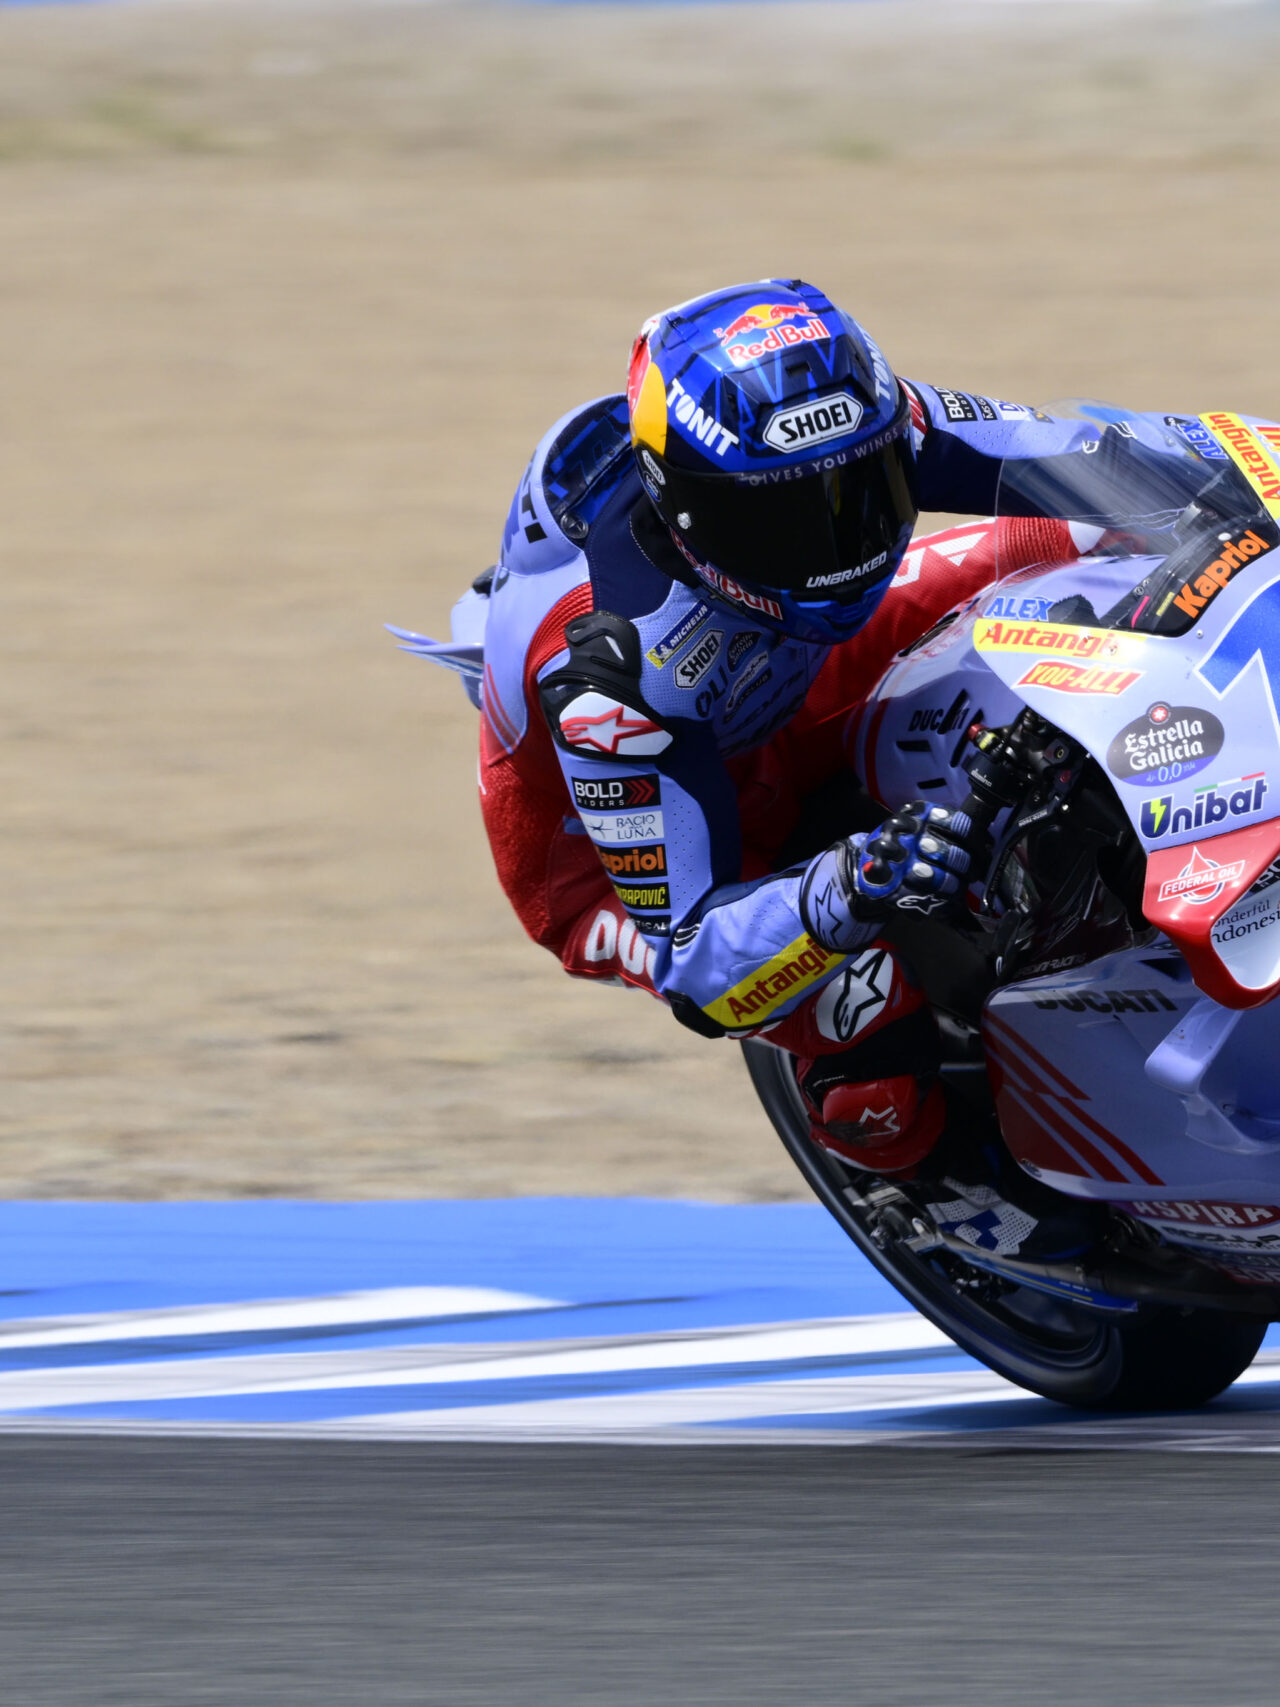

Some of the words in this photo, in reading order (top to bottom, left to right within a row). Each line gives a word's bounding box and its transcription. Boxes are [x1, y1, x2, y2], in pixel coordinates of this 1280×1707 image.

[726, 331, 781, 367] Red
[781, 318, 831, 346] Bull
[666, 378, 740, 457] TONIT
[779, 401, 852, 443] SHOEI
[749, 467, 803, 487] GIVES
[811, 453, 848, 472] YOU
[855, 428, 900, 460] WINGS
[1179, 422, 1229, 460] ALEX
[1173, 530, 1270, 620] Kapriol
[669, 604, 709, 648] MICHELIN
[983, 597, 1056, 622] ALEX
[680, 635, 720, 683] SHOEI
[1025, 663, 1130, 694] YOU-ALL
[1124, 719, 1204, 754] Estrella
[1129, 739, 1204, 771] Galicia
[573, 781, 624, 799] BOLD
[577, 797, 625, 807] RIDERS
[1141, 779, 1267, 839] Unibat
[617, 827, 657, 840] LUNA
[1164, 872, 1217, 895] FEDERAL
[1218, 865, 1239, 881] OIL
[1027, 988, 1179, 1014] DUCATI
